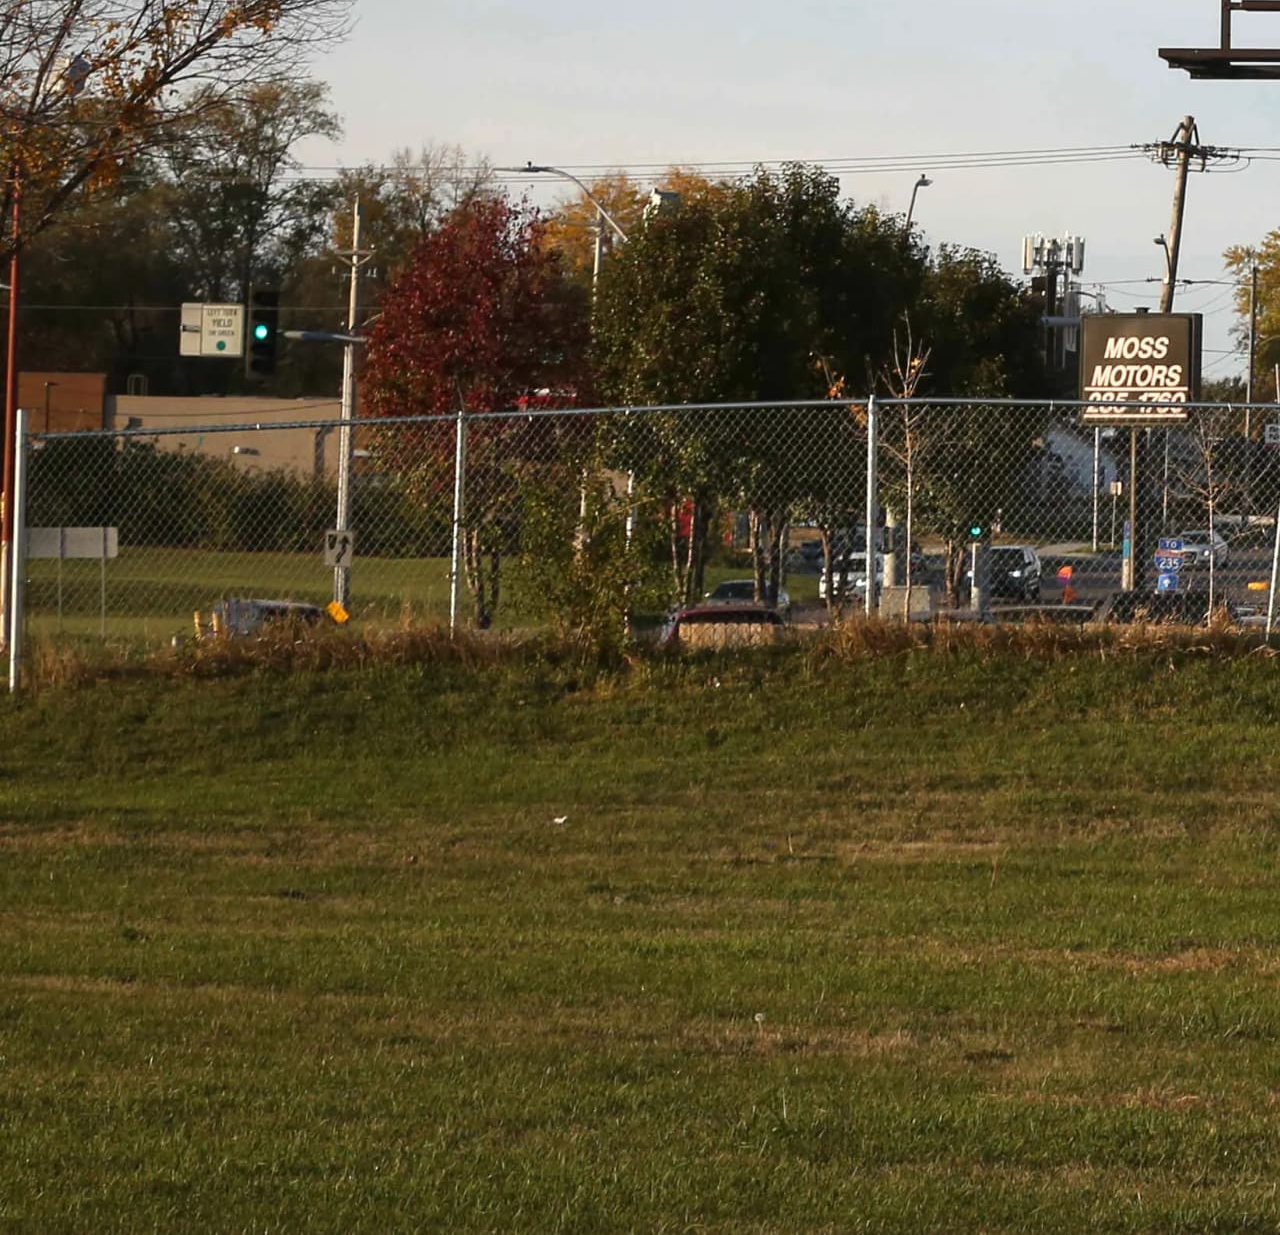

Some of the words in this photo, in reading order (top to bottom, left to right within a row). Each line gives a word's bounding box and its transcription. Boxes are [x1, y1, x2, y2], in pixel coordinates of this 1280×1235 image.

[1104, 337, 1169, 359] MOSS
[1091, 365, 1182, 387] MOTORS
[1159, 557, 1180, 569] 235
